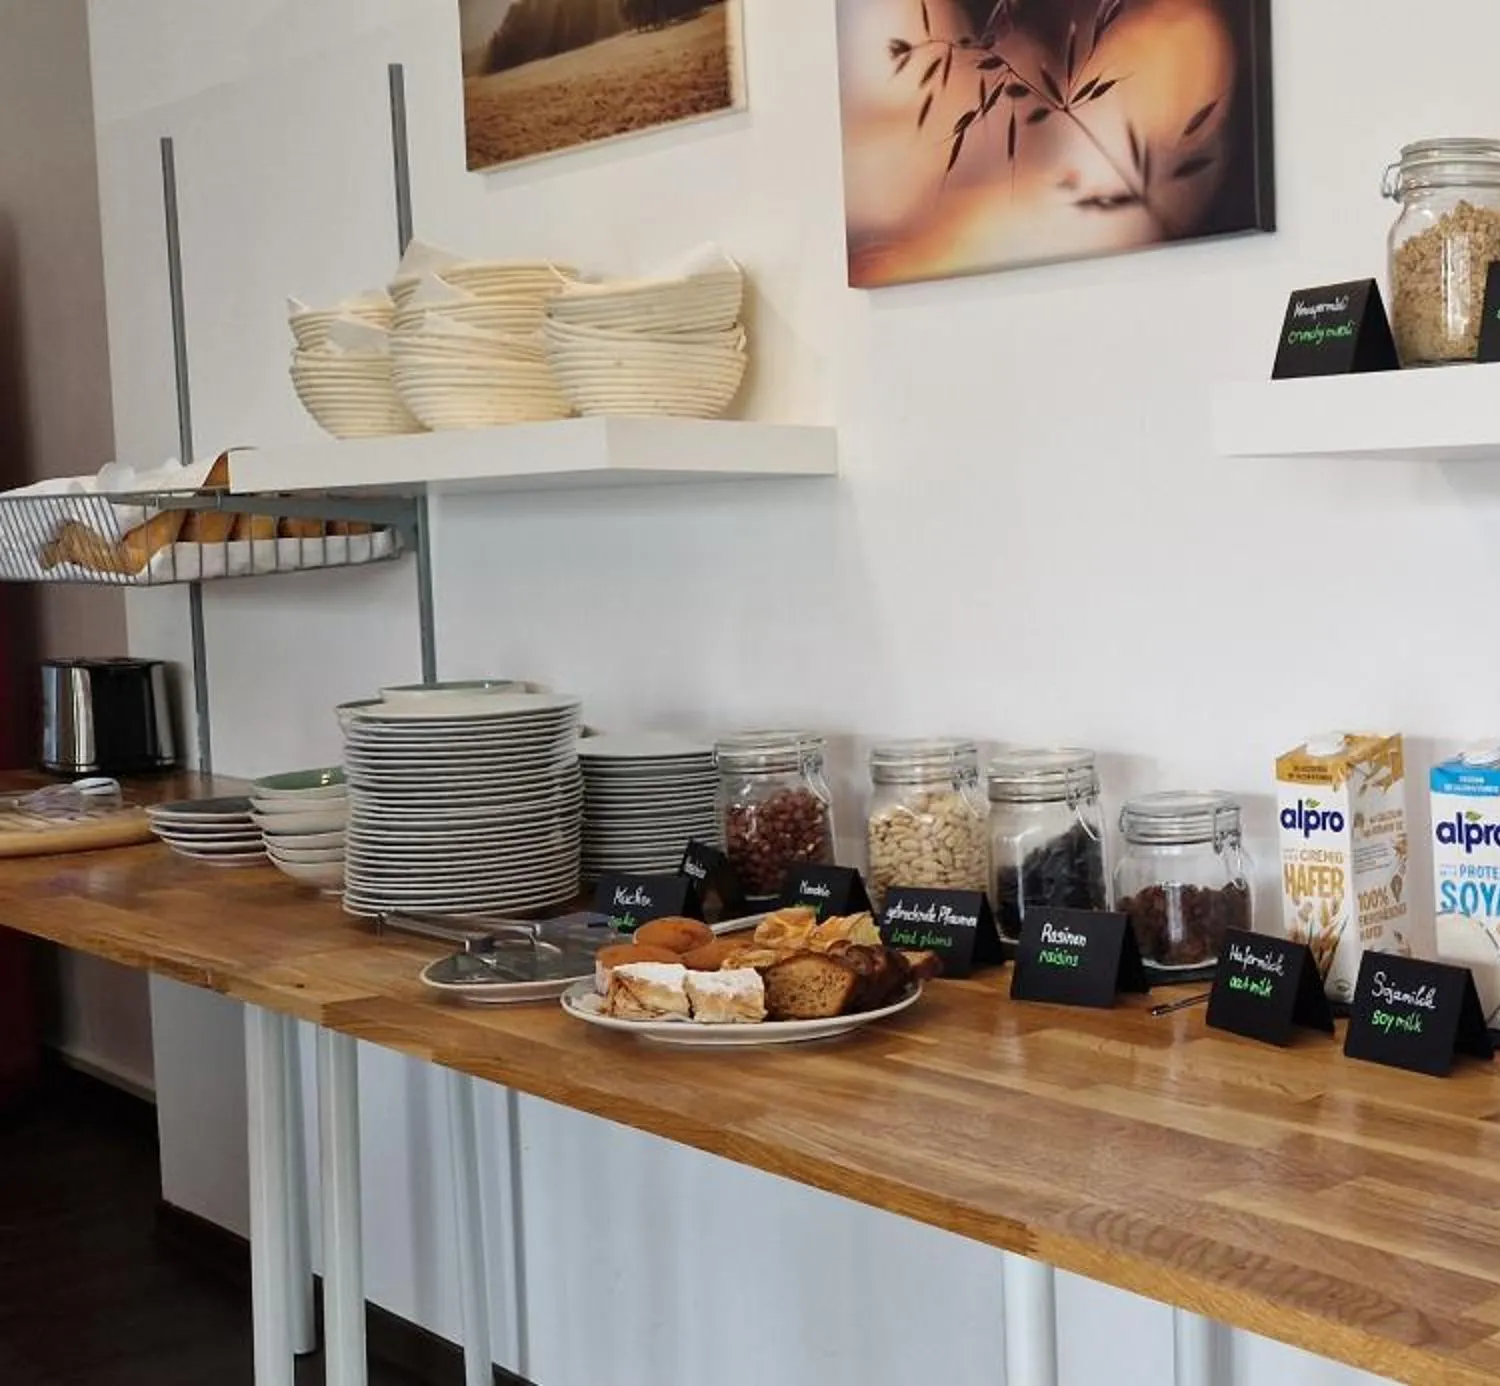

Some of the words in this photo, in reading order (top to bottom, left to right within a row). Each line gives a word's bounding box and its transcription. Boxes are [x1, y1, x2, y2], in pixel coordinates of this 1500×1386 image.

[1280, 799, 1344, 839] alpro
[1284, 863, 1344, 900] HAFER
[1371, 971, 1437, 1009] Sojamilch
[1371, 1009, 1395, 1034] soy
